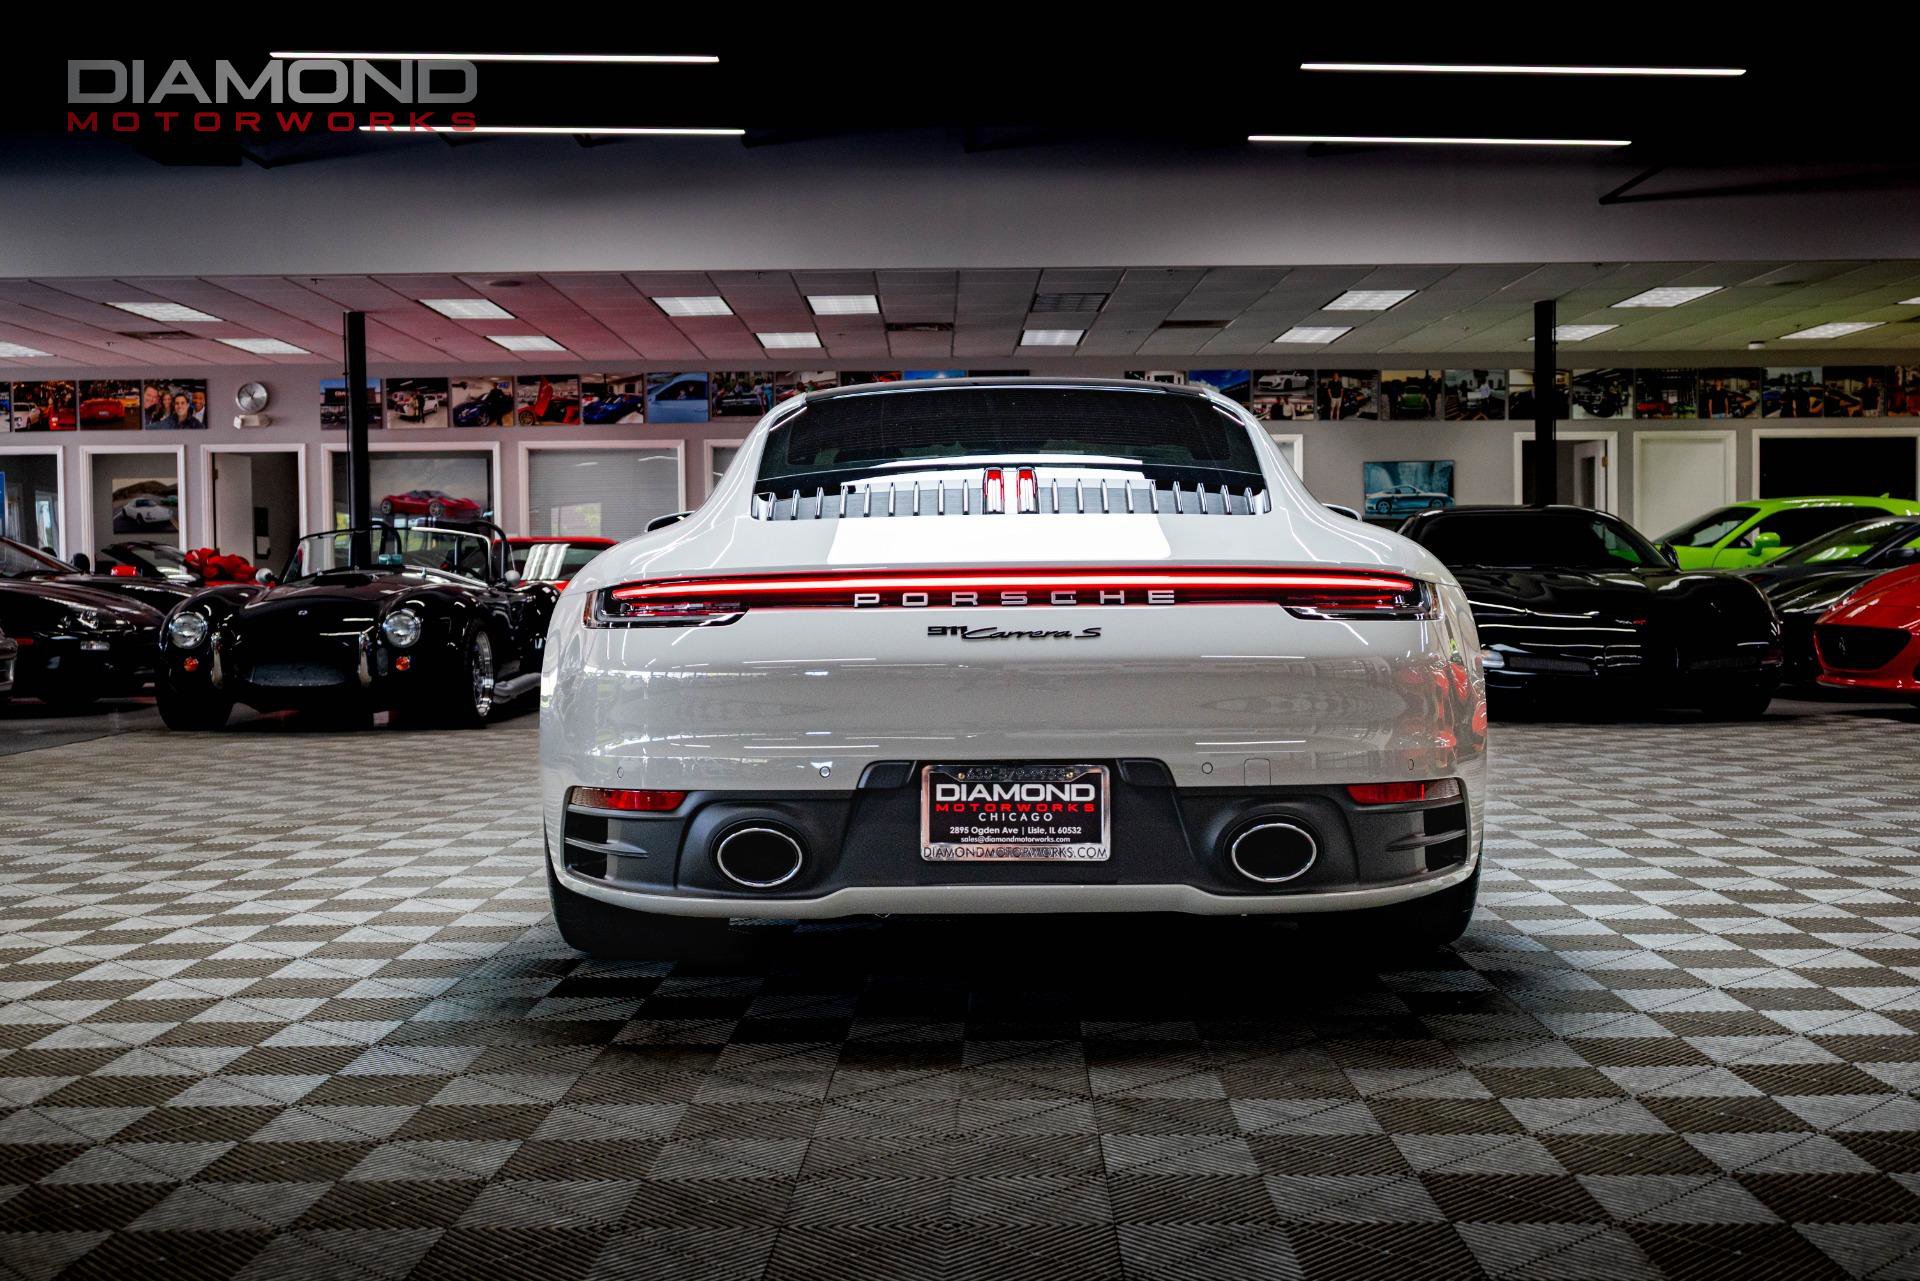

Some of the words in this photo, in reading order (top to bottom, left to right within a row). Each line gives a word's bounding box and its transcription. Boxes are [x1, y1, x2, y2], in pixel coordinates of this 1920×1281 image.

[854, 590, 1175, 607] PORSCHE
[927, 625, 967, 636] 911
[961, 626, 1073, 639] Carrera
[1074, 627, 1102, 638] S
[935, 783, 1096, 802] DIAMOND
[935, 803, 1096, 812] MOTORWORKS
[978, 812, 1053, 822] CHICAGO
[949, 826, 969, 834] 2895
[970, 826, 1000, 835] Ogden
[1001, 826, 1019, 834] Ave
[1027, 826, 1048, 835] Lisle,
[1049, 826, 1056, 834] IL
[1057, 826, 1082, 834] 60532
[923, 847, 1108, 858] DIAMONDMOTORWORKS.COM
